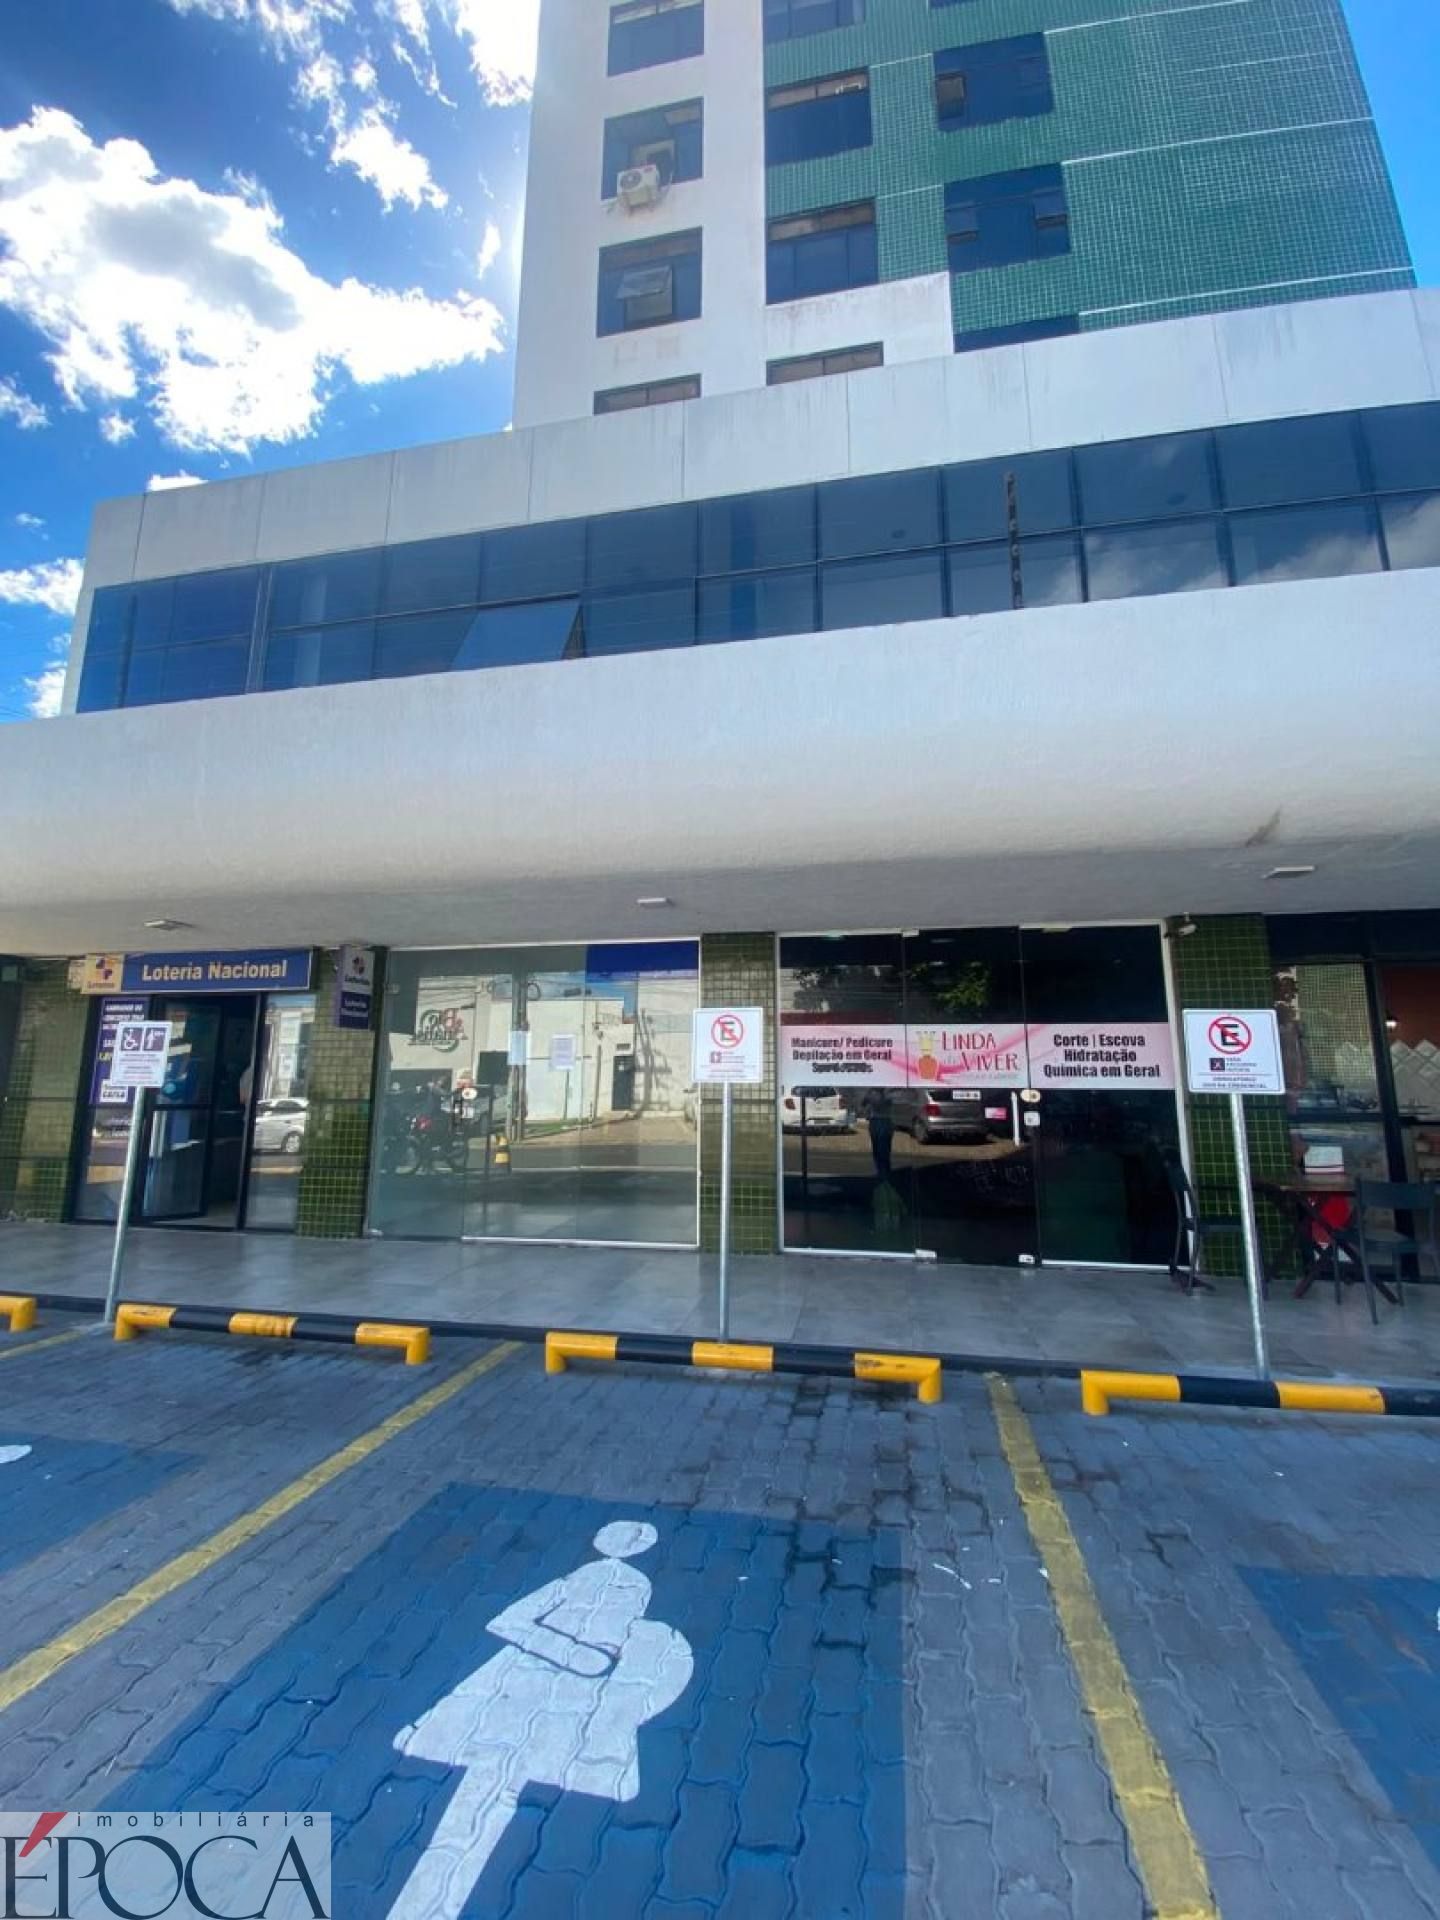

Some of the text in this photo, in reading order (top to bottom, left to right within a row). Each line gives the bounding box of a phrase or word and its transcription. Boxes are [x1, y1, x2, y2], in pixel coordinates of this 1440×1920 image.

[142, 959, 287, 981] Loteria Nacional
[846, 1037, 893, 1048] Pedicure
[942, 1030, 997, 1051] LINDA
[1053, 1034, 1089, 1047] Corte
[1098, 1034, 1146, 1047] Escova
[792, 1050, 843, 1061] Depilação
[863, 1049, 892, 1060] Geral
[961, 1051, 1021, 1071] VIVER
[1064, 1049, 1137, 1063] Hidratação
[1100, 1066, 1121, 1077] em
[1124, 1064, 1160, 1078] Geral
